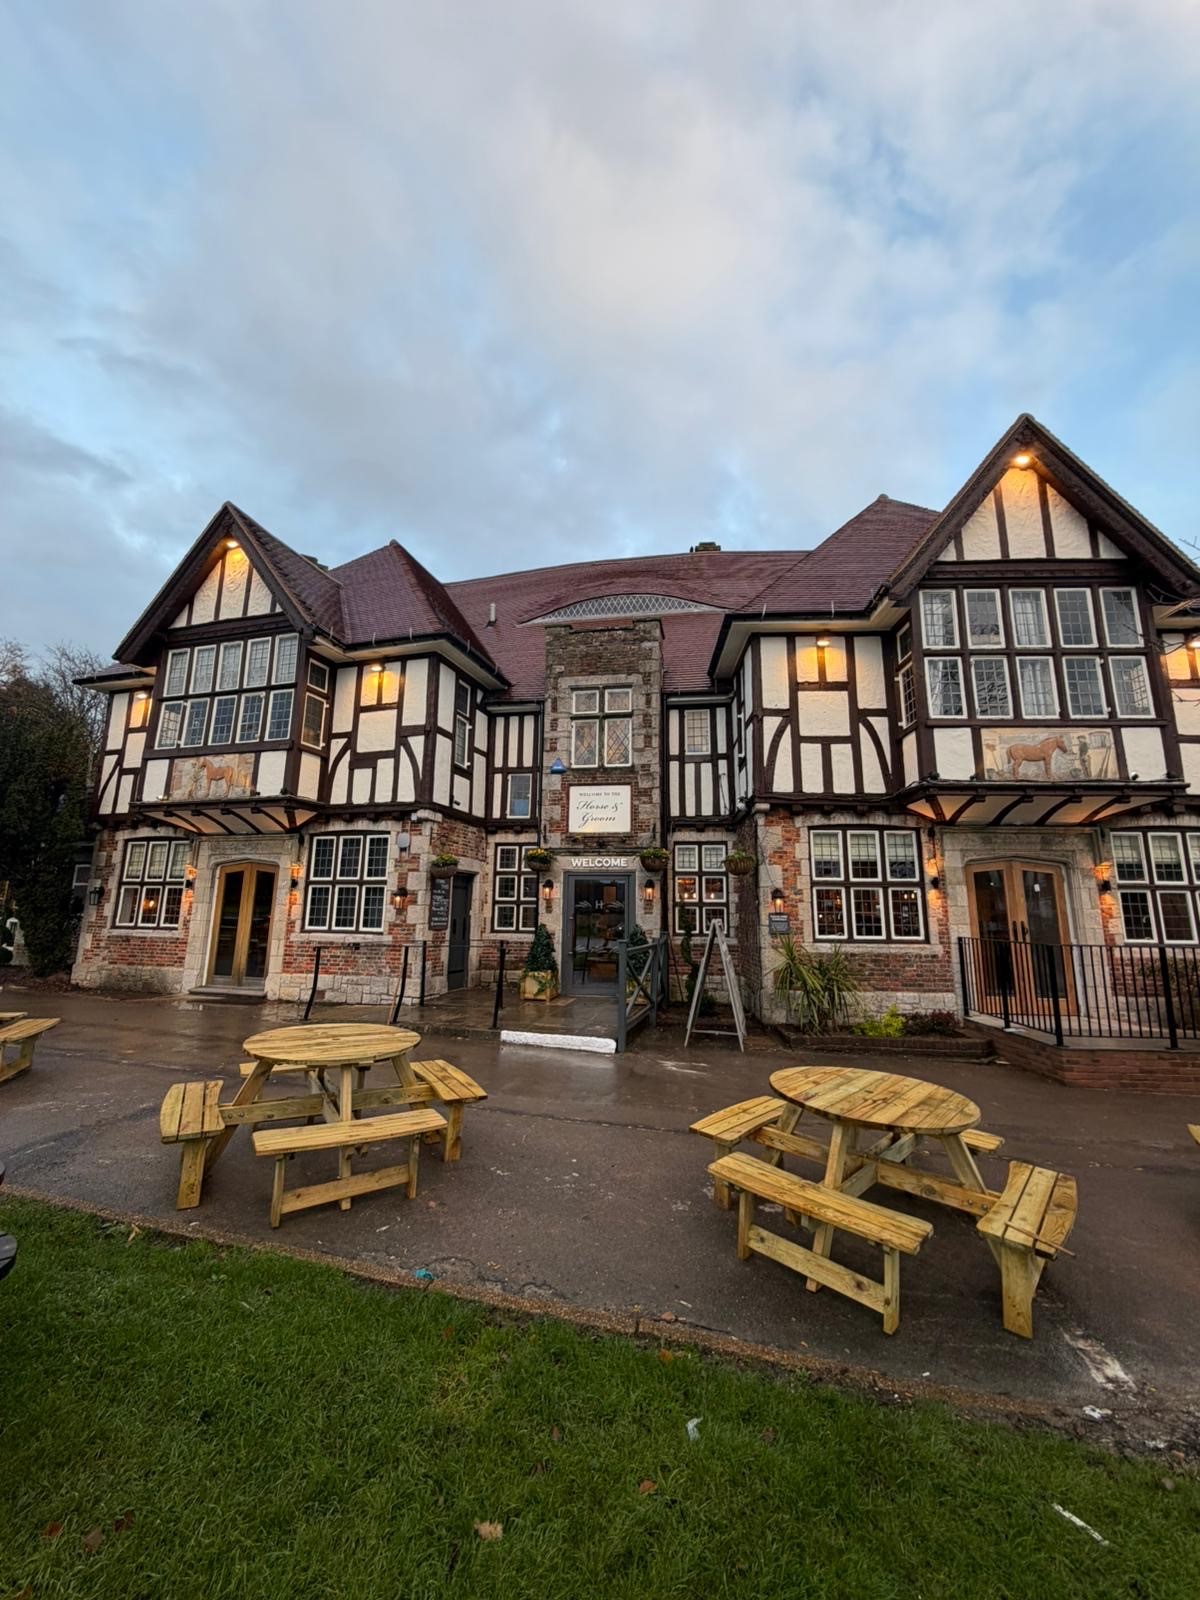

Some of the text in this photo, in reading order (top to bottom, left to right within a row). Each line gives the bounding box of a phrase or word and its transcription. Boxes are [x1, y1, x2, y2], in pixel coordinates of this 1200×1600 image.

[576, 800, 623, 812] Horse &
[578, 812, 616, 828] Groom
[571, 858, 628, 867] WELCOME
